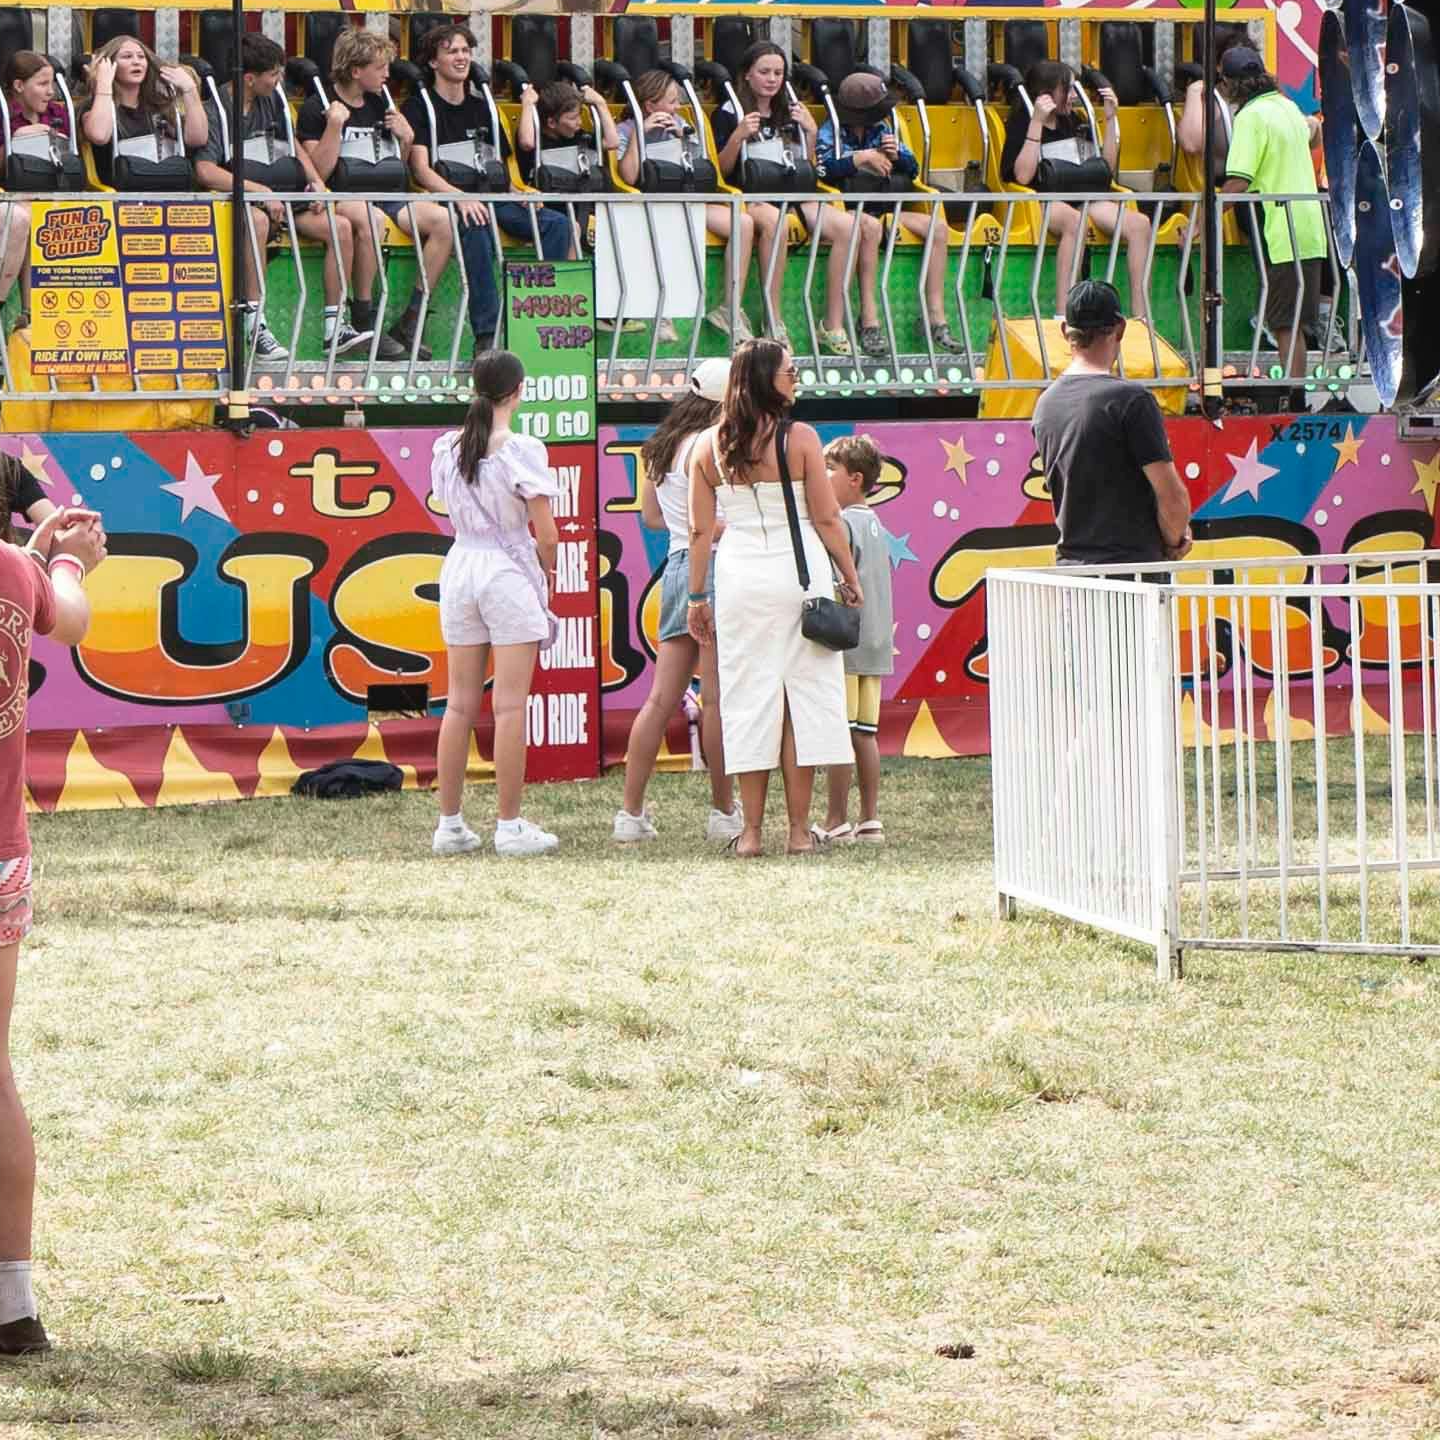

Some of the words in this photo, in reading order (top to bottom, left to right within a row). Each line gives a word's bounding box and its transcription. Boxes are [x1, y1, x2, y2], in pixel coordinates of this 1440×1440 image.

[48, 211, 83, 227] FUN
[40, 223, 106, 242] SAFETY
[983, 227, 1001, 243] 13
[47, 240, 99, 257] GUIDE
[175, 266, 187, 281] NO
[506, 263, 556, 288] THE
[512, 295, 589, 319] MUSIC
[537, 325, 593, 350] TRIP
[35, 350, 59, 362] RIDE
[60, 350, 74, 362] AT
[75, 350, 100, 362] OWN
[102, 350, 126, 362] RISK
[521, 374, 588, 402] GOOD
[518, 411, 550, 438] TO
[556, 410, 590, 437] GO
[1269, 423, 1284, 442] X
[1289, 422, 1341, 441] 2574
[556, 540, 590, 594] ARE
[547, 692, 589, 746] RIDE
